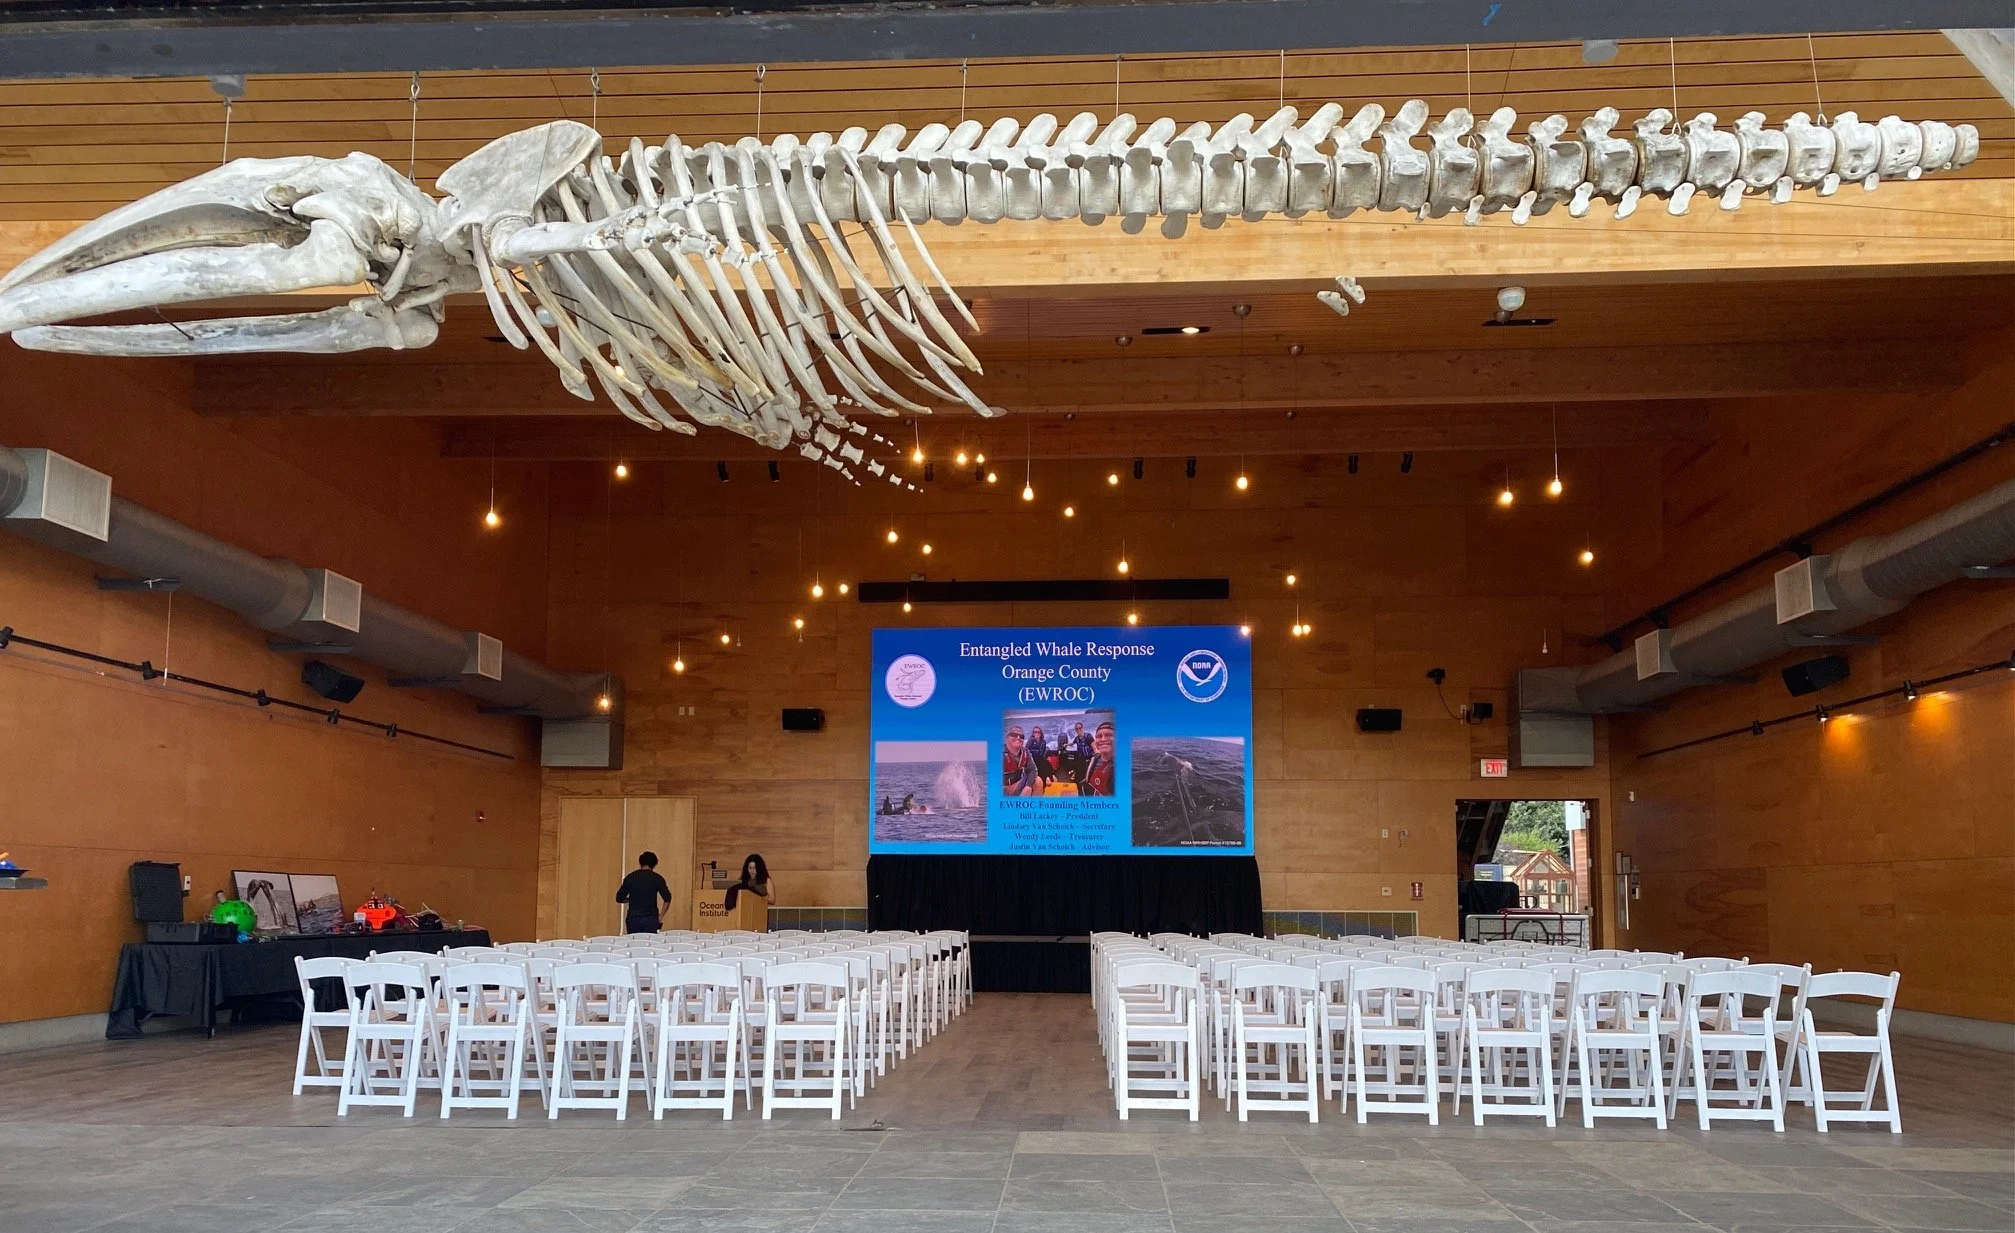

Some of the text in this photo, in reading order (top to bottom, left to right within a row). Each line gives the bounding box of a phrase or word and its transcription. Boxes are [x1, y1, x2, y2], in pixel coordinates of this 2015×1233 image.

[959, 641, 1155, 660] Entangled Whale Response
[1192, 661, 1211, 669] NOAA
[1002, 664, 1111, 682] Orange County
[1018, 687, 1095, 704] (EWROC)
[1486, 762, 1504, 775] EXIT
[999, 801, 1120, 811] EWROC Founding Members
[1034, 813, 1058, 821] Lackey
[1003, 823, 1029, 831] Lindsey
[1082, 823, 1115, 831] Secretary
[1015, 833, 1039, 841] Wendy
[699, 901, 724, 909] Ocean
[699, 909, 729, 917] Institute
